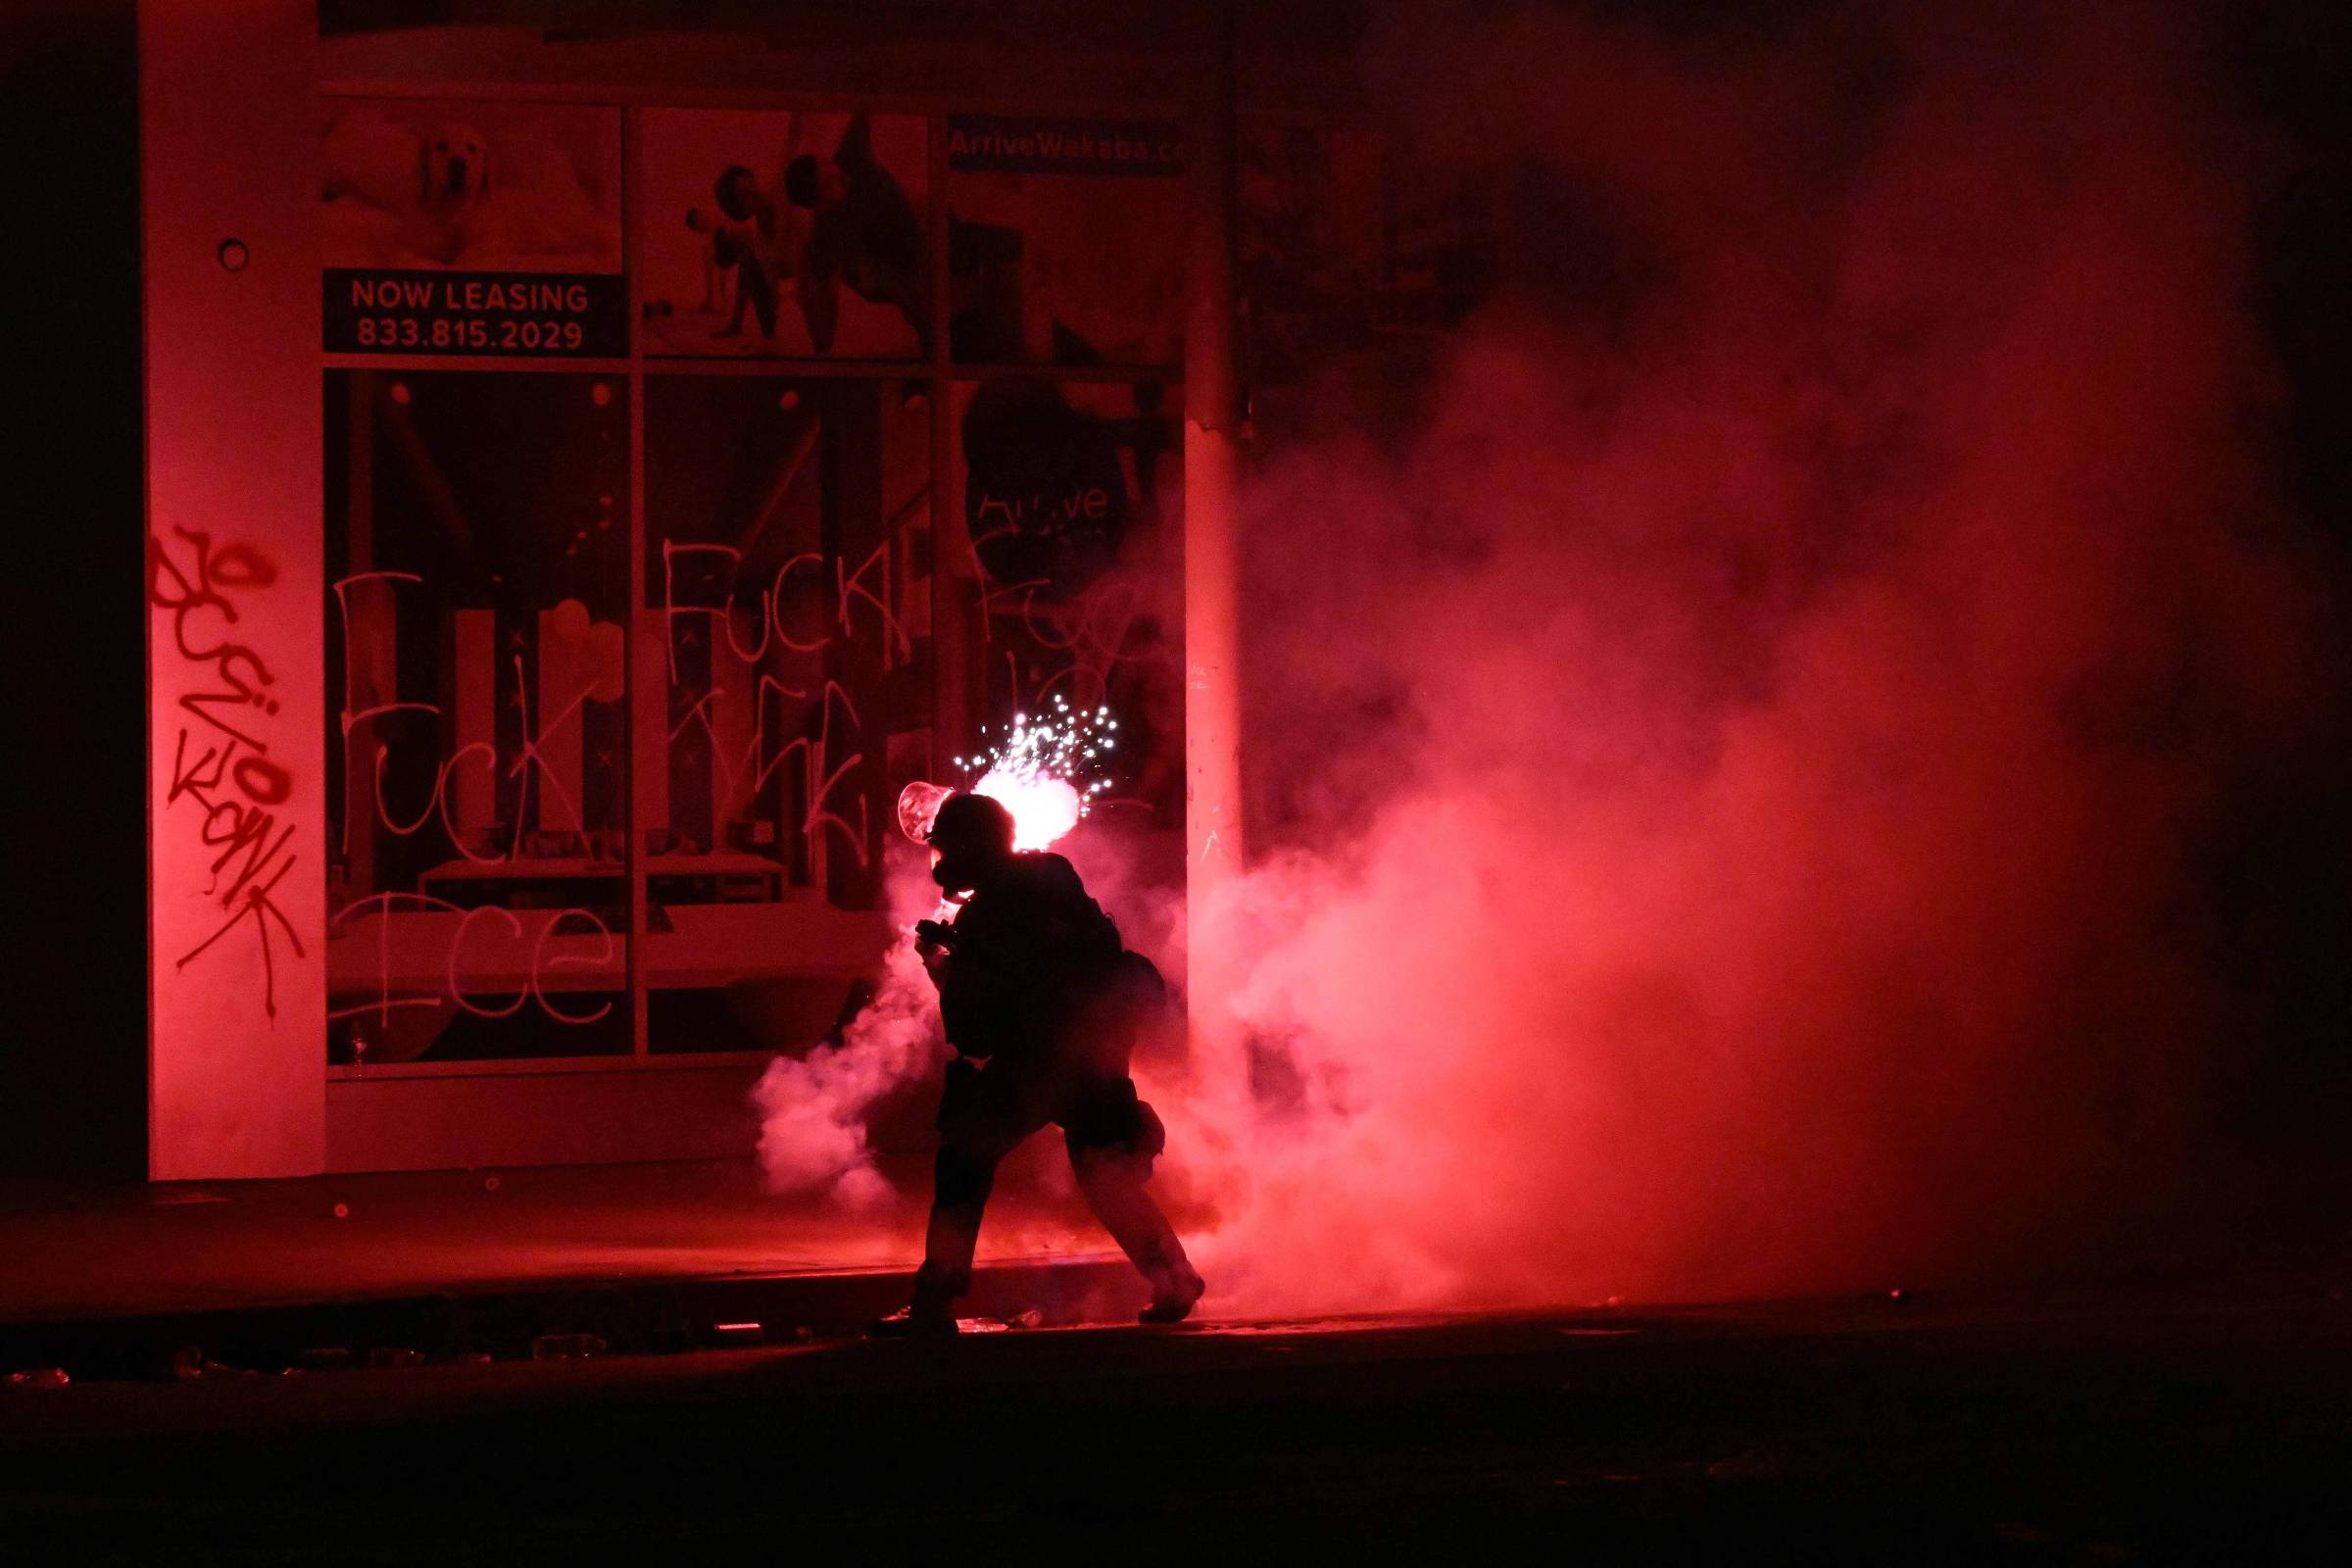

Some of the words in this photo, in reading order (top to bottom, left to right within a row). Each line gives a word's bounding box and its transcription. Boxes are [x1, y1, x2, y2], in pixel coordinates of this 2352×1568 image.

[351, 279, 434, 309] NOW
[444, 280, 589, 313] LEASING
[357, 317, 583, 350] 833.815.2029
